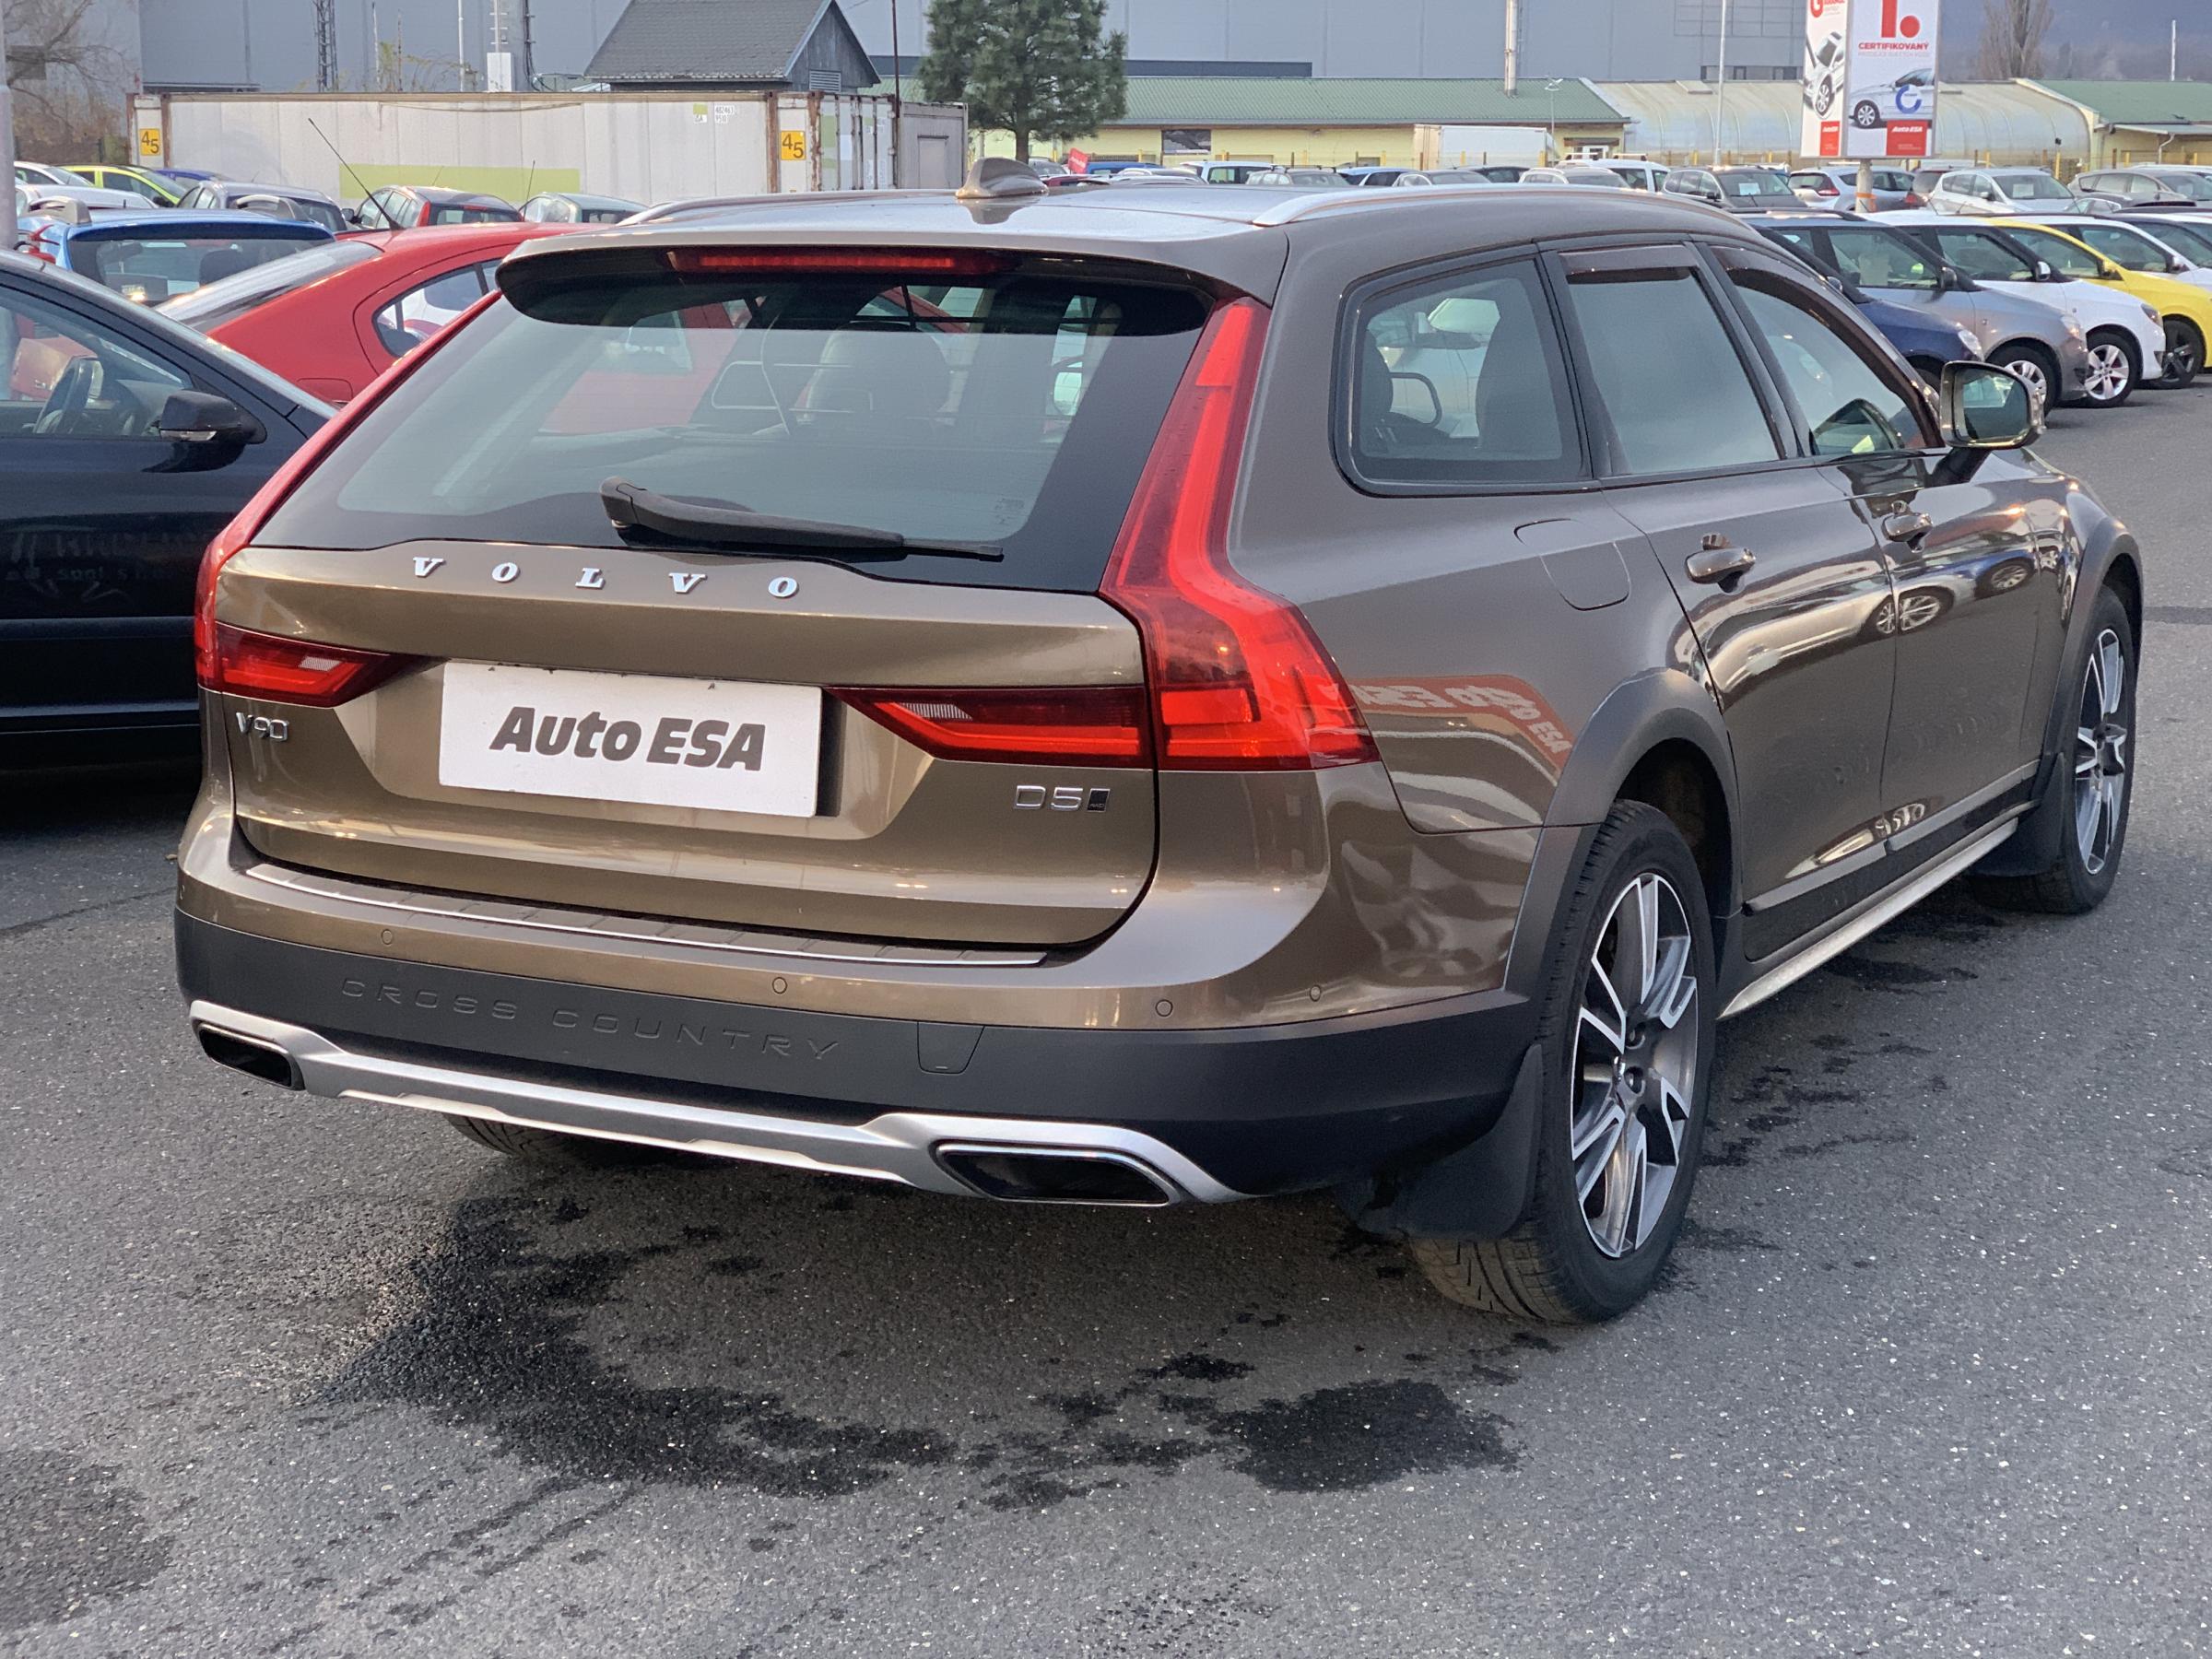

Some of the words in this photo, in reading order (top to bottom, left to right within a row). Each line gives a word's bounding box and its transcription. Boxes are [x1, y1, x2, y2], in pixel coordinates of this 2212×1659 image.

[1858, 41, 1929, 51] CERTIFIKOVANÝ
[141, 131, 159, 154] 45
[782, 133, 804, 159] 45
[413, 557, 799, 598] VOLVO
[236, 712, 288, 741] V90
[489, 706, 641, 762] Auto
[646, 717, 766, 772] ESA
[1014, 785, 1084, 811] D5
[342, 978, 518, 1020] CROSS
[552, 1010, 840, 1059] COUNTRY
